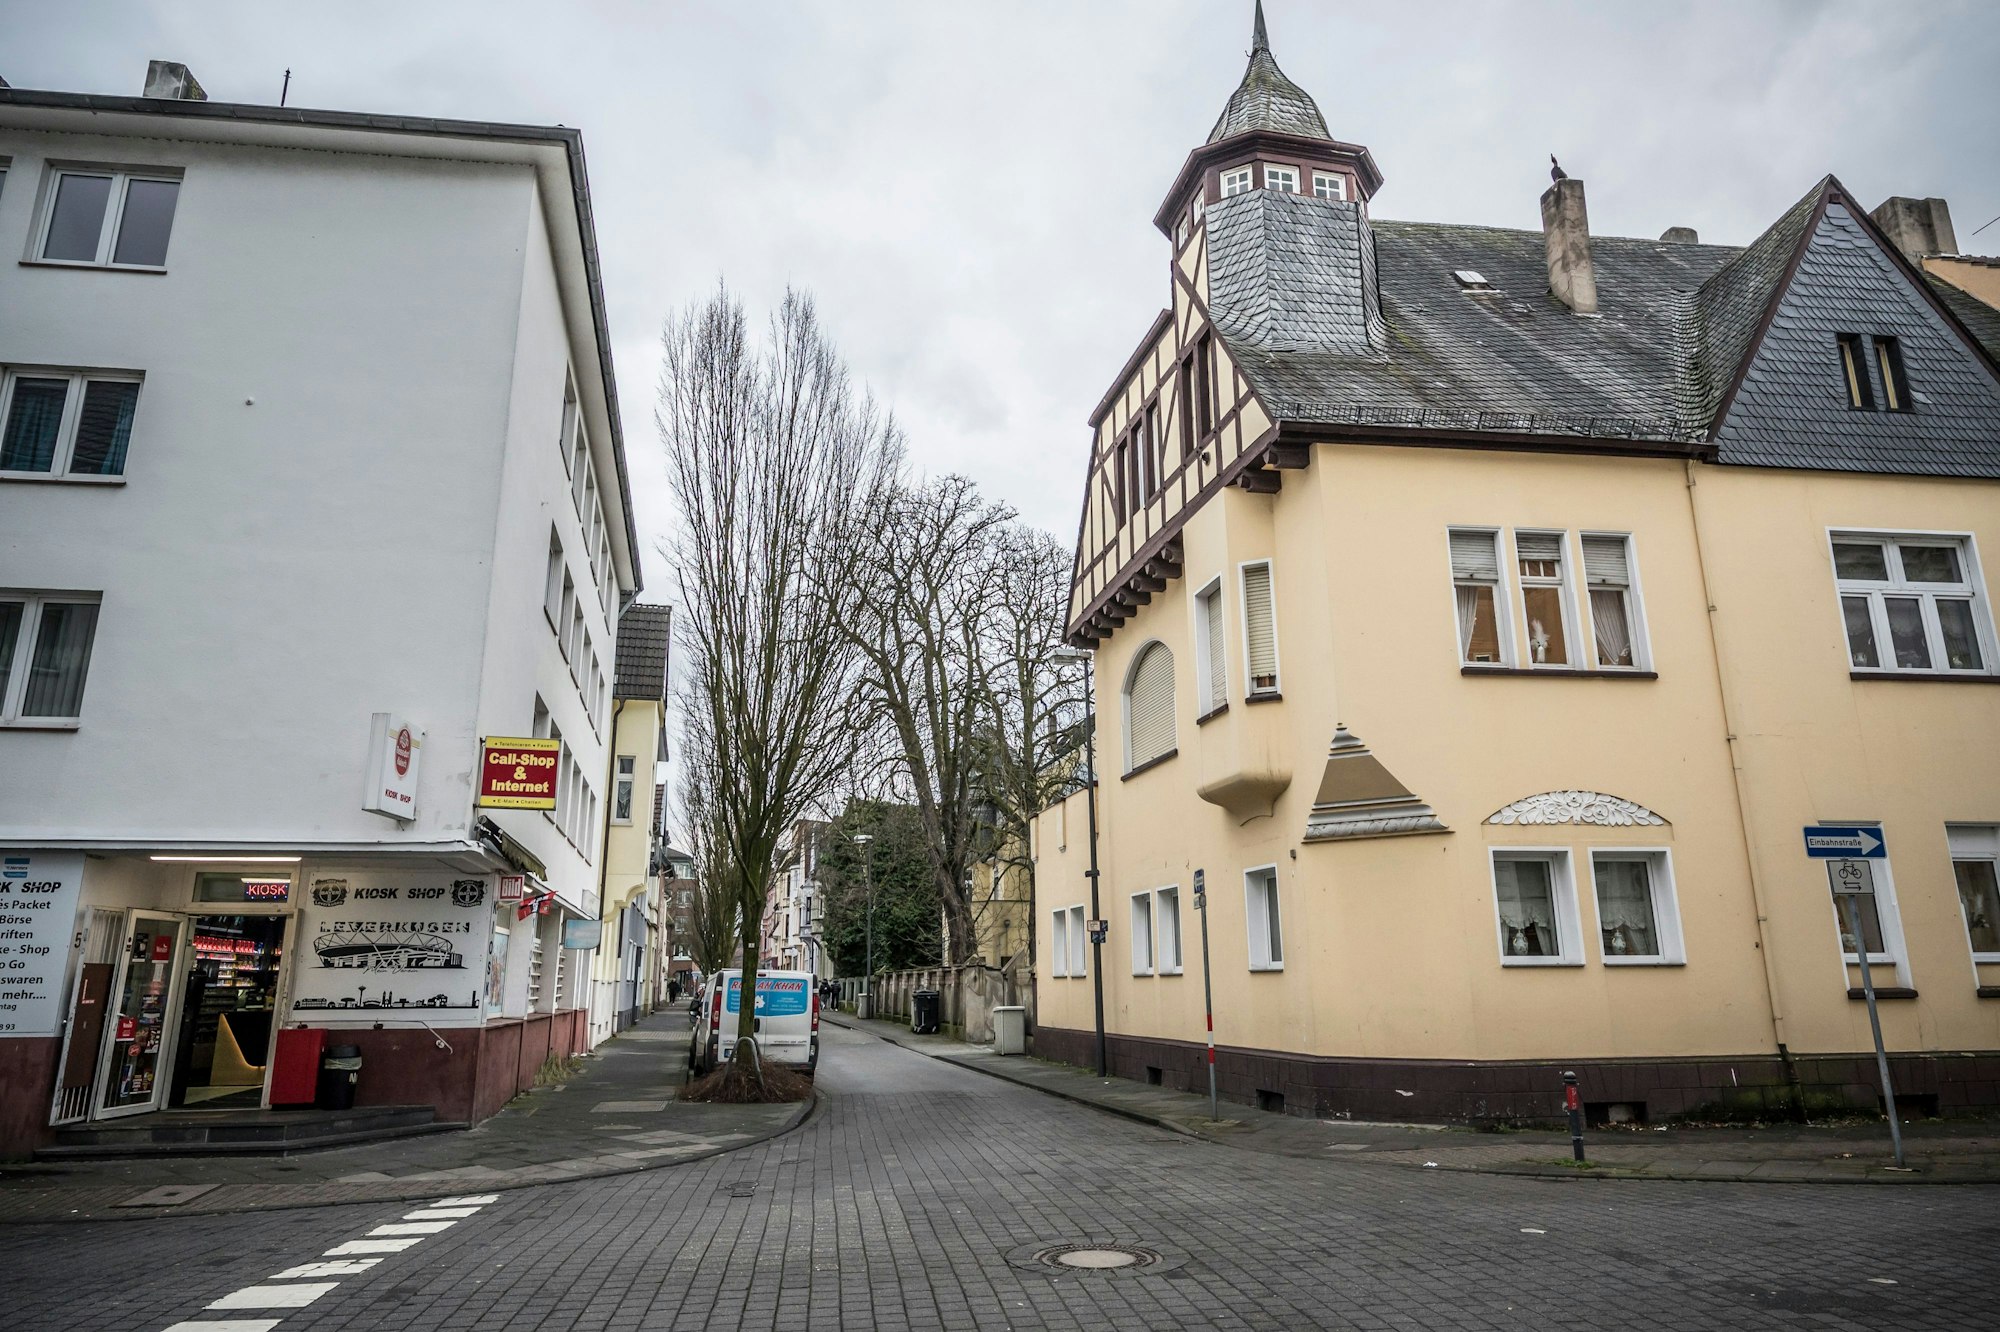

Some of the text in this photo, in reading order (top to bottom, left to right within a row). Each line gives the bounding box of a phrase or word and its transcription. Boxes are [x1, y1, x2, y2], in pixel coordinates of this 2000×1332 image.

[489, 752, 556, 769] Call-Shop
[513, 766, 527, 780] &
[491, 779, 549, 793] Internet
[384, 788, 412, 804] KIOSK SHOP
[1809, 838, 1862, 847] Einbahnstraße
[21, 881, 61, 893] SHOP
[248, 884, 286, 896] KIOSK
[354, 887, 445, 899] KIOSK SHOP
[502, 878, 521, 897] Bild
[12, 899, 51, 909] Packet
[0, 914, 32, 924] Börse
[320, 921, 470, 933] LEVERKUSEN
[74, 932, 83, 949] 5
[19, 944, 50, 956] Shop
[9, 959, 25, 969] Go
[774, 982, 803, 991] KHAN
